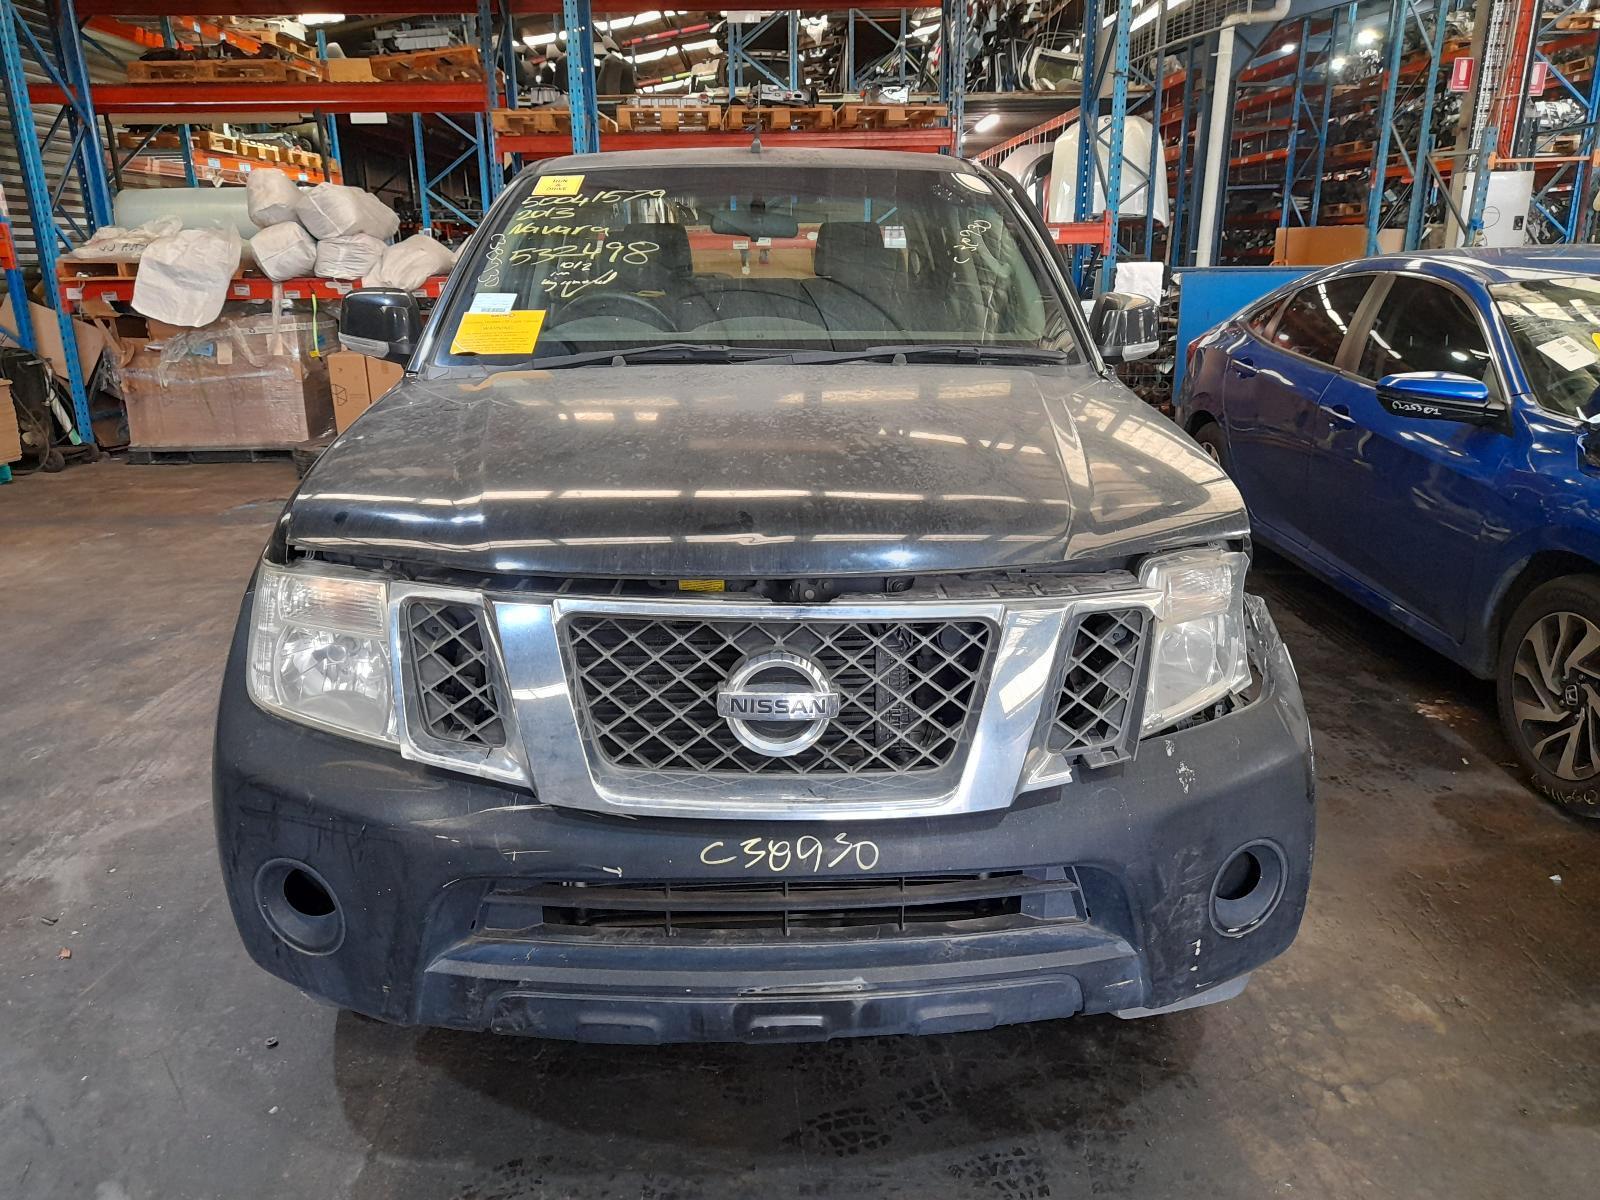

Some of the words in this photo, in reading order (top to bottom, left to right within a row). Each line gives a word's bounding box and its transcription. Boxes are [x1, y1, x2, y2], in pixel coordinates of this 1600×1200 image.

[515, 207, 575, 221] 2013
[508, 222, 610, 237] Navara
[509, 241, 660, 267] 532498
[729, 697, 826, 715] NISSAN
[699, 832, 880, 873] C38930
